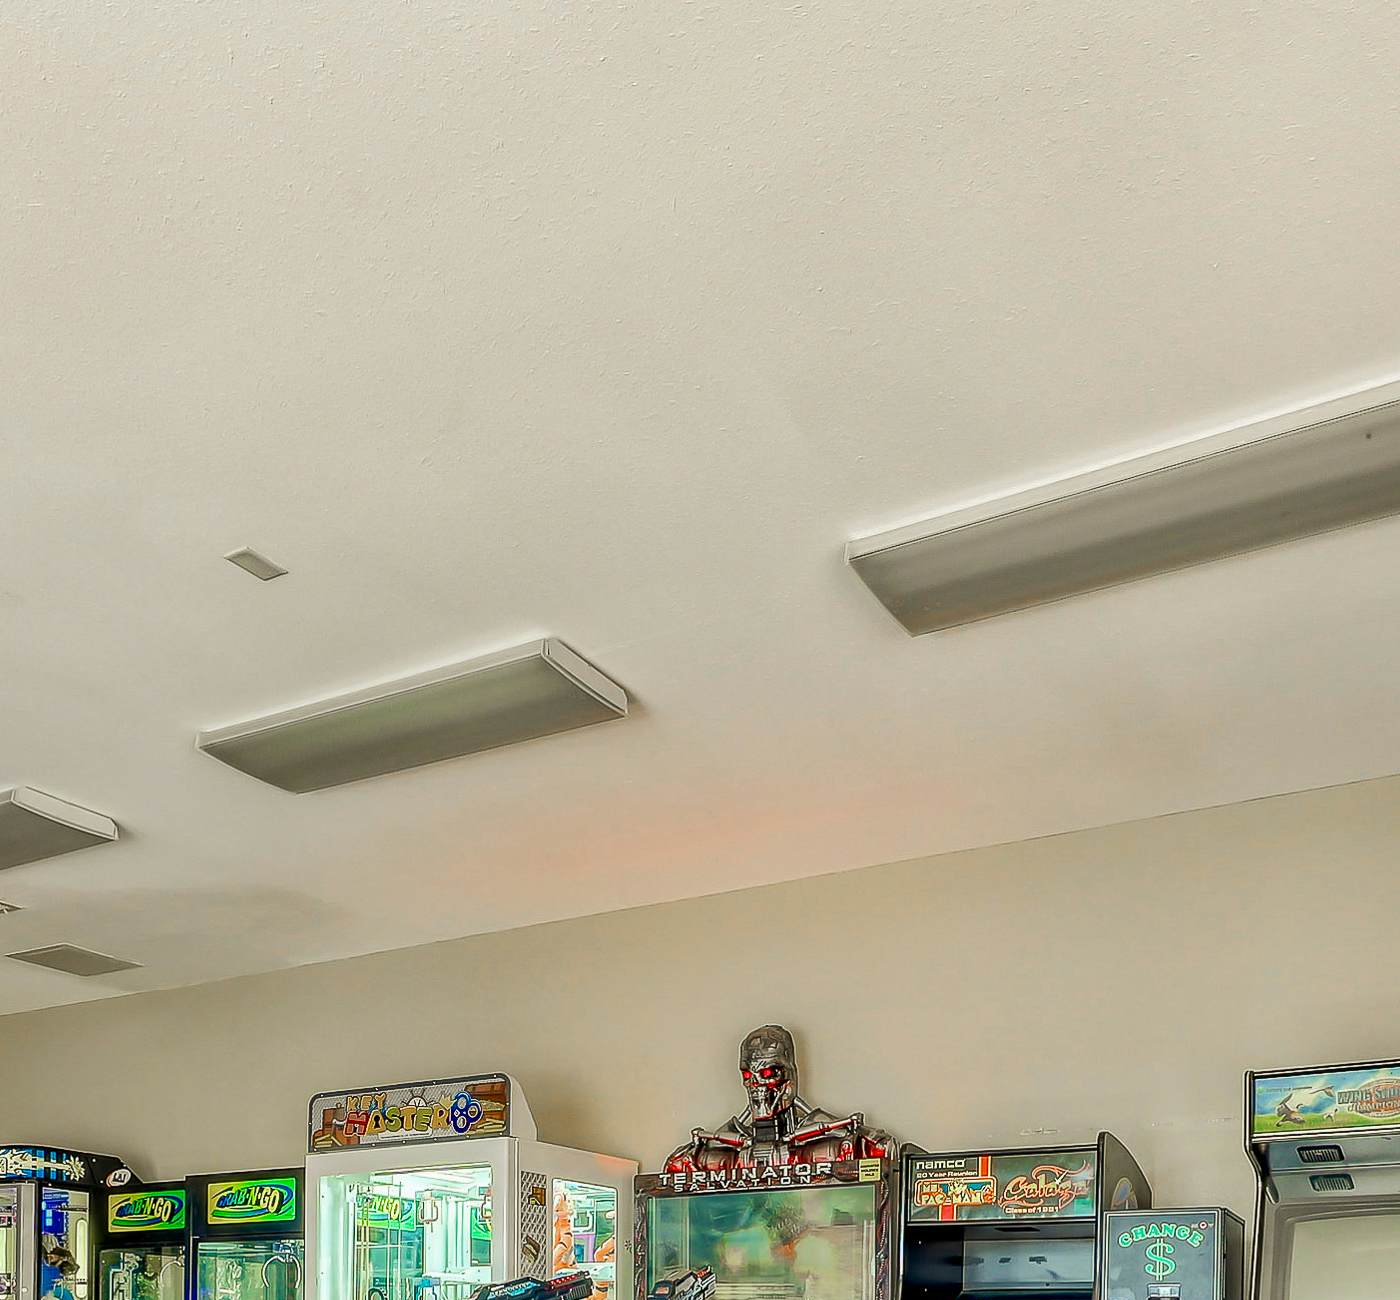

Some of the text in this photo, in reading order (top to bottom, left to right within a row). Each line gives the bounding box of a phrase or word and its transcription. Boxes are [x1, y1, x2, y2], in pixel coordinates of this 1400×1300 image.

[347, 1092, 387, 1112] KEY
[343, 1103, 449, 1137] MASTER
[659, 1162, 832, 1186] TERMINATOR
[916, 1159, 965, 1169] namco
[673, 1175, 812, 1193] SALVATION
[1118, 1223, 1205, 1248] CHANGE
[1145, 1238, 1176, 1281] $
